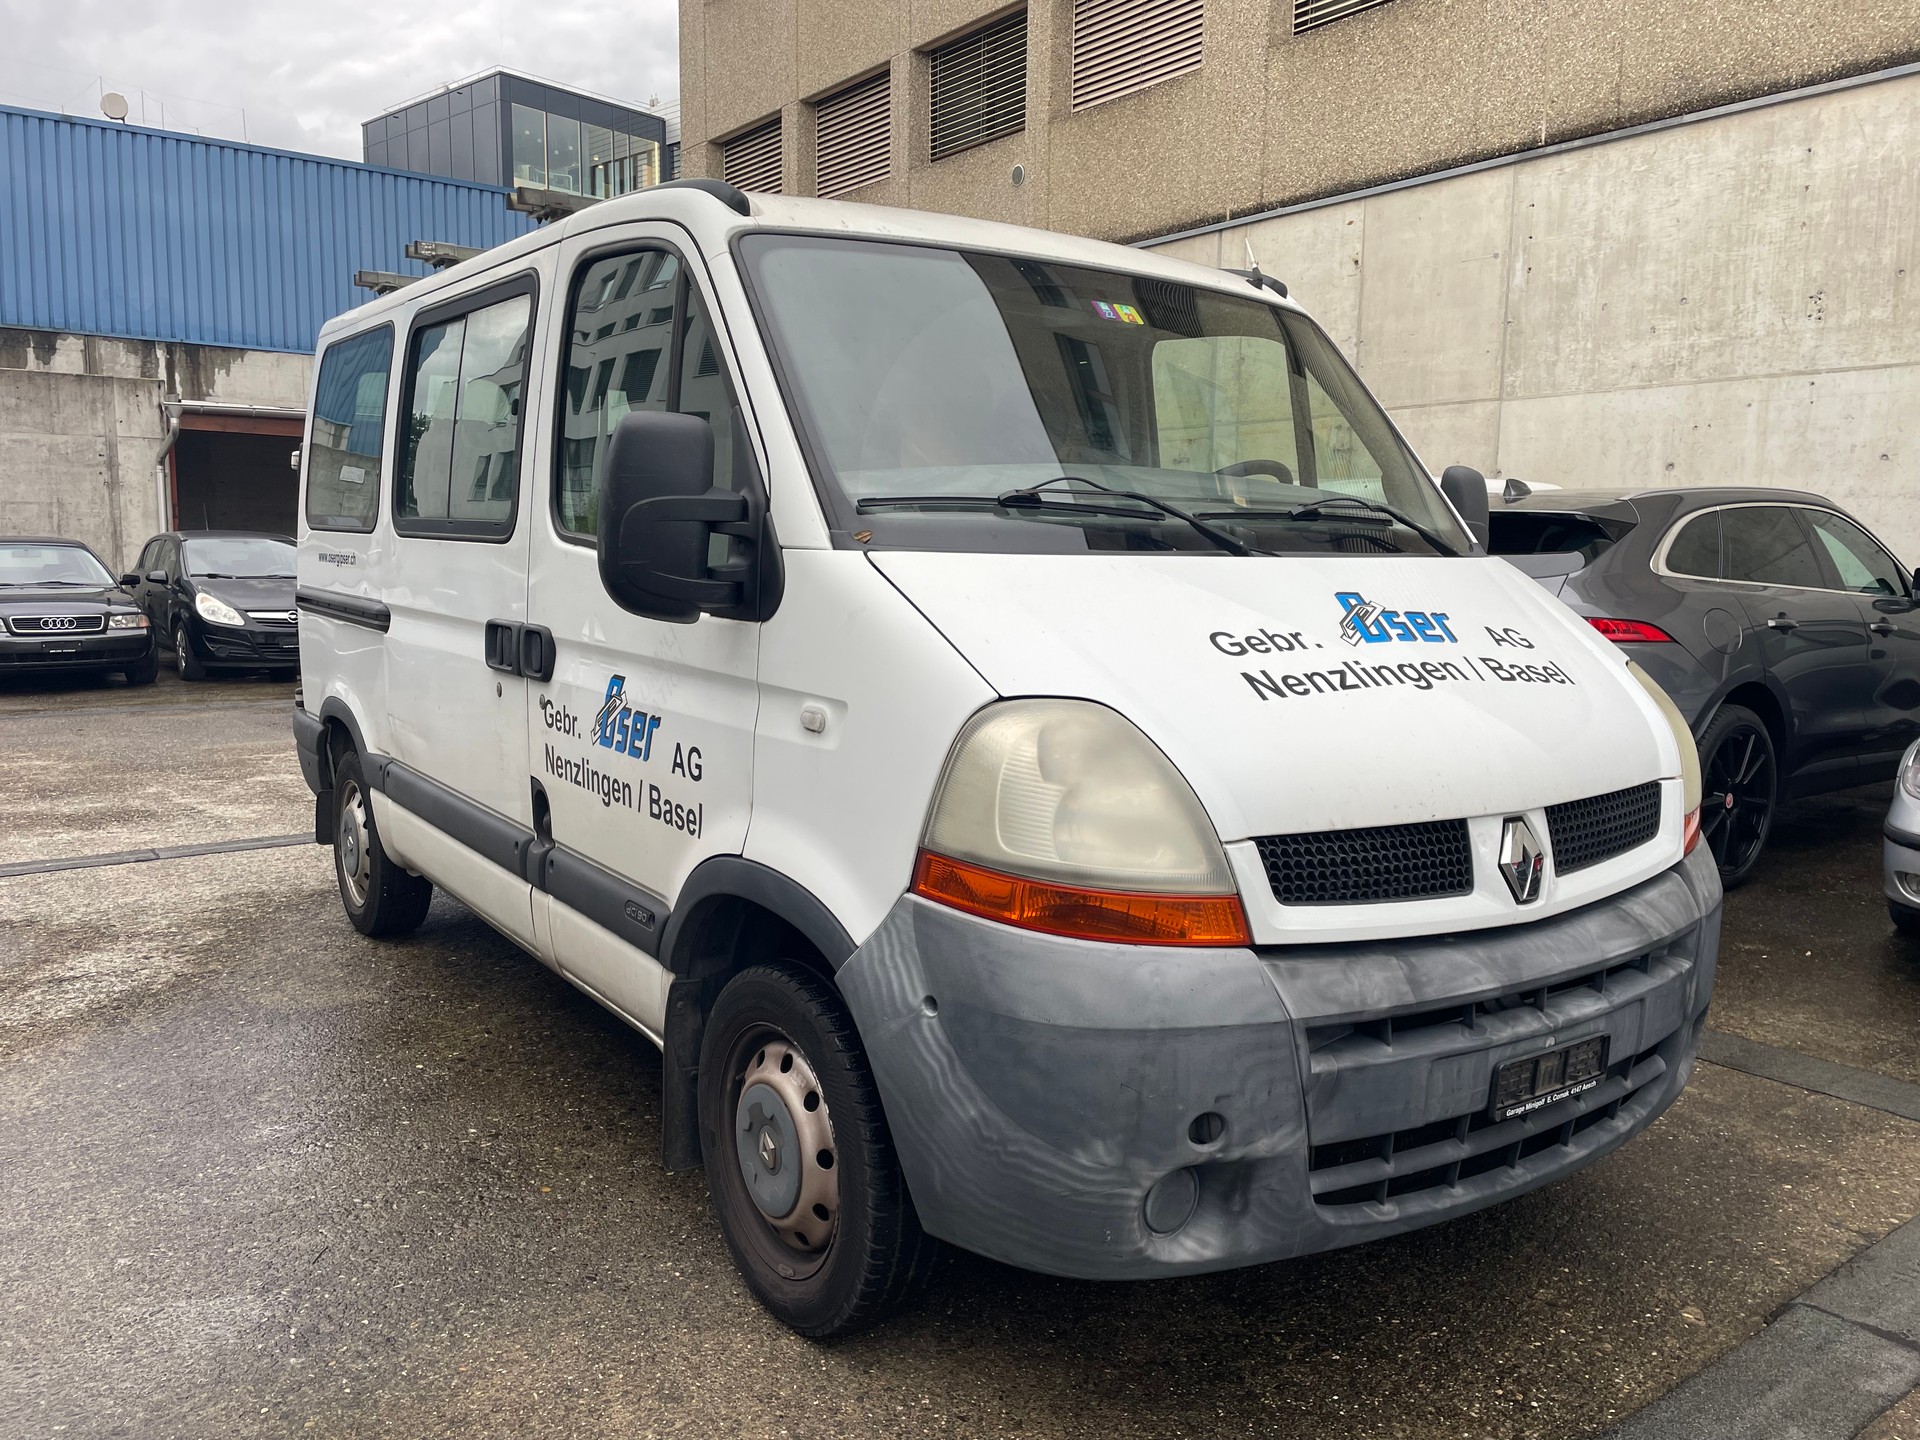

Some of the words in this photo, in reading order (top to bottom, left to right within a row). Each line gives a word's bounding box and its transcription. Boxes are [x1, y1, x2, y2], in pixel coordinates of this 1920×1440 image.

[1209, 628, 1324, 657] Gebr.
[1484, 626, 1535, 649] AG
[1240, 660, 1470, 701] Nenzlingen
[1463, 656, 1486, 681] /
[1478, 656, 1576, 685] Basel
[544, 699, 582, 739] Gebr.
[671, 742, 703, 782] AG
[545, 743, 632, 808] Nenzlingen
[637, 779, 643, 813] /
[649, 784, 703, 839] Basel
[1506, 1106, 1525, 1117] Garage
[1525, 1098, 1545, 1110] Minigolf
[1570, 1086, 1582, 1094] 4147
